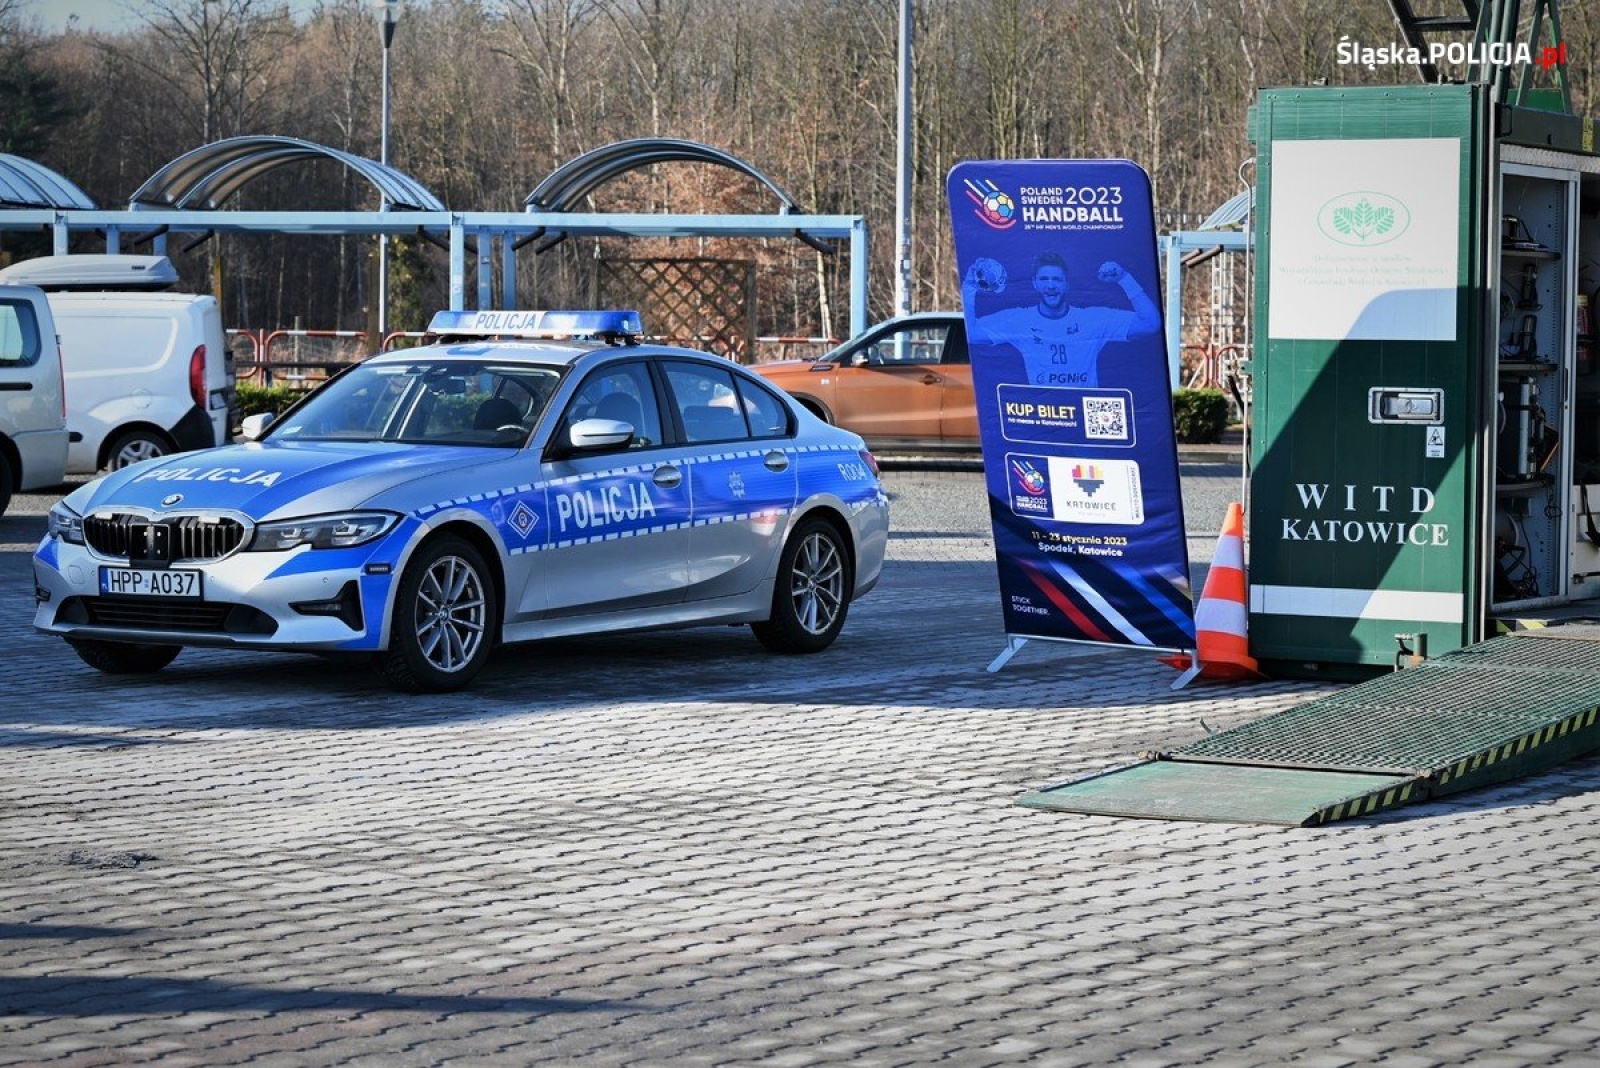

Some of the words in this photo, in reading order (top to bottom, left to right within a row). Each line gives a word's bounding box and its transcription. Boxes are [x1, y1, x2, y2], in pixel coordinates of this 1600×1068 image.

[1020, 187, 1062, 196] POLAND
[1066, 187, 1123, 205] 2023
[1021, 196, 1064, 205] SWEDEN
[1023, 207, 1124, 222] HANDBALL
[476, 313, 537, 329] POLICJA
[1051, 344, 1068, 365] 28
[1049, 372, 1088, 384] PGNiG
[1006, 402, 1034, 416] KUP
[1038, 405, 1076, 420] BILET
[132, 467, 282, 487] POLICJA
[556, 482, 657, 533] POLICJA
[1066, 500, 1117, 511] KATOWICE
[1031, 531, 1041, 540] 11
[1062, 534, 1101, 545] stycznia
[1103, 536, 1128, 546] 2023
[1281, 518, 1449, 547] KATOWICE
[1038, 542, 1077, 555] Spodek,
[1078, 545, 1124, 557] Katowice
[111, 570, 143, 593] HPP
[150, 572, 195, 595] A037
